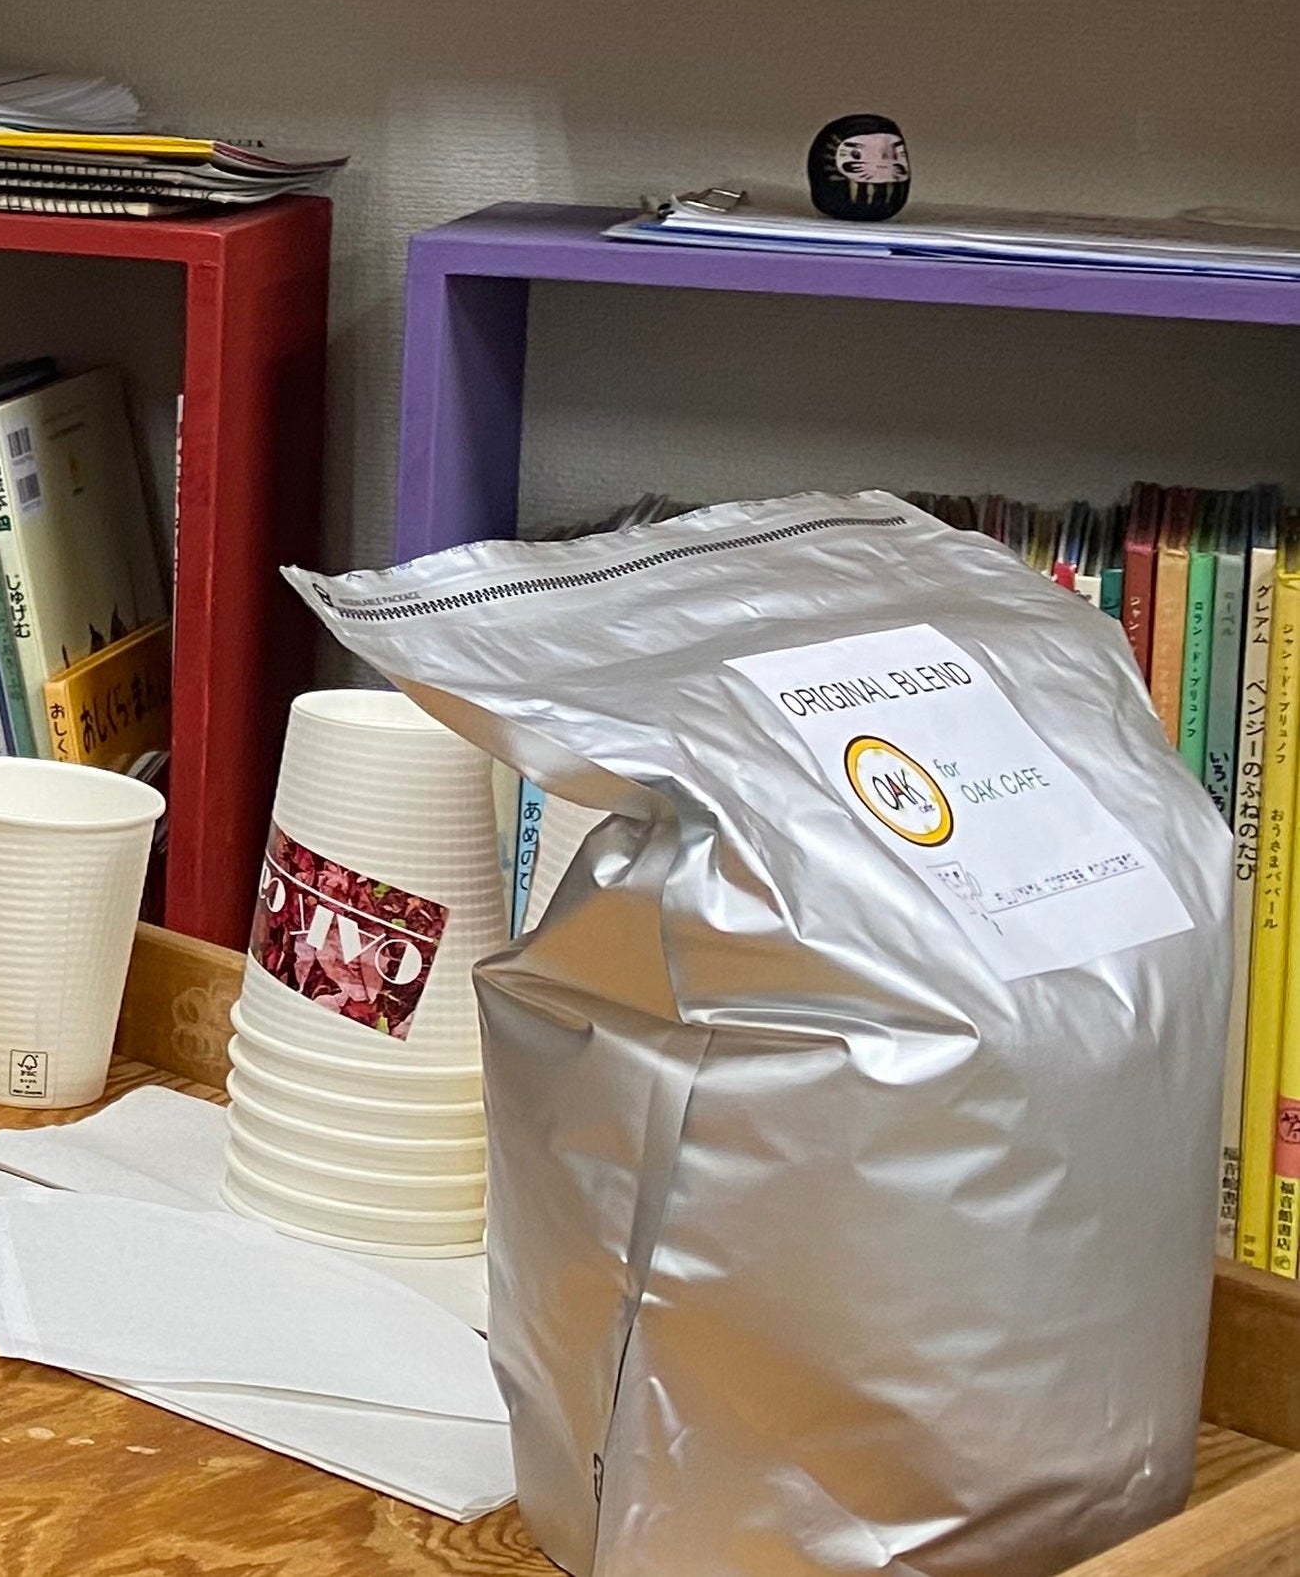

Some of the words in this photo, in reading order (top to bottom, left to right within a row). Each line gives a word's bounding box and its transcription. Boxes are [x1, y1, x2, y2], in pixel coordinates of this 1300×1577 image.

[5, 573, 31, 639] じゅげむ
[1252, 585, 1273, 644] グレアム
[779, 675, 900, 717] ORIGINAL
[887, 661, 973, 696] BLEND
[1188, 600, 1204, 739] ロラン・ド・ブリュノフ
[1275, 623, 1295, 764] ジャン・ド・ブリュノフ
[50, 702, 68, 763] おしく
[872, 768, 927, 811] OAK
[932, 758, 960, 779] for
[960, 777, 1004, 805] OAK
[1000, 767, 1051, 795] CAFE
[1236, 680, 1268, 881] ベンジーのふねのたび
